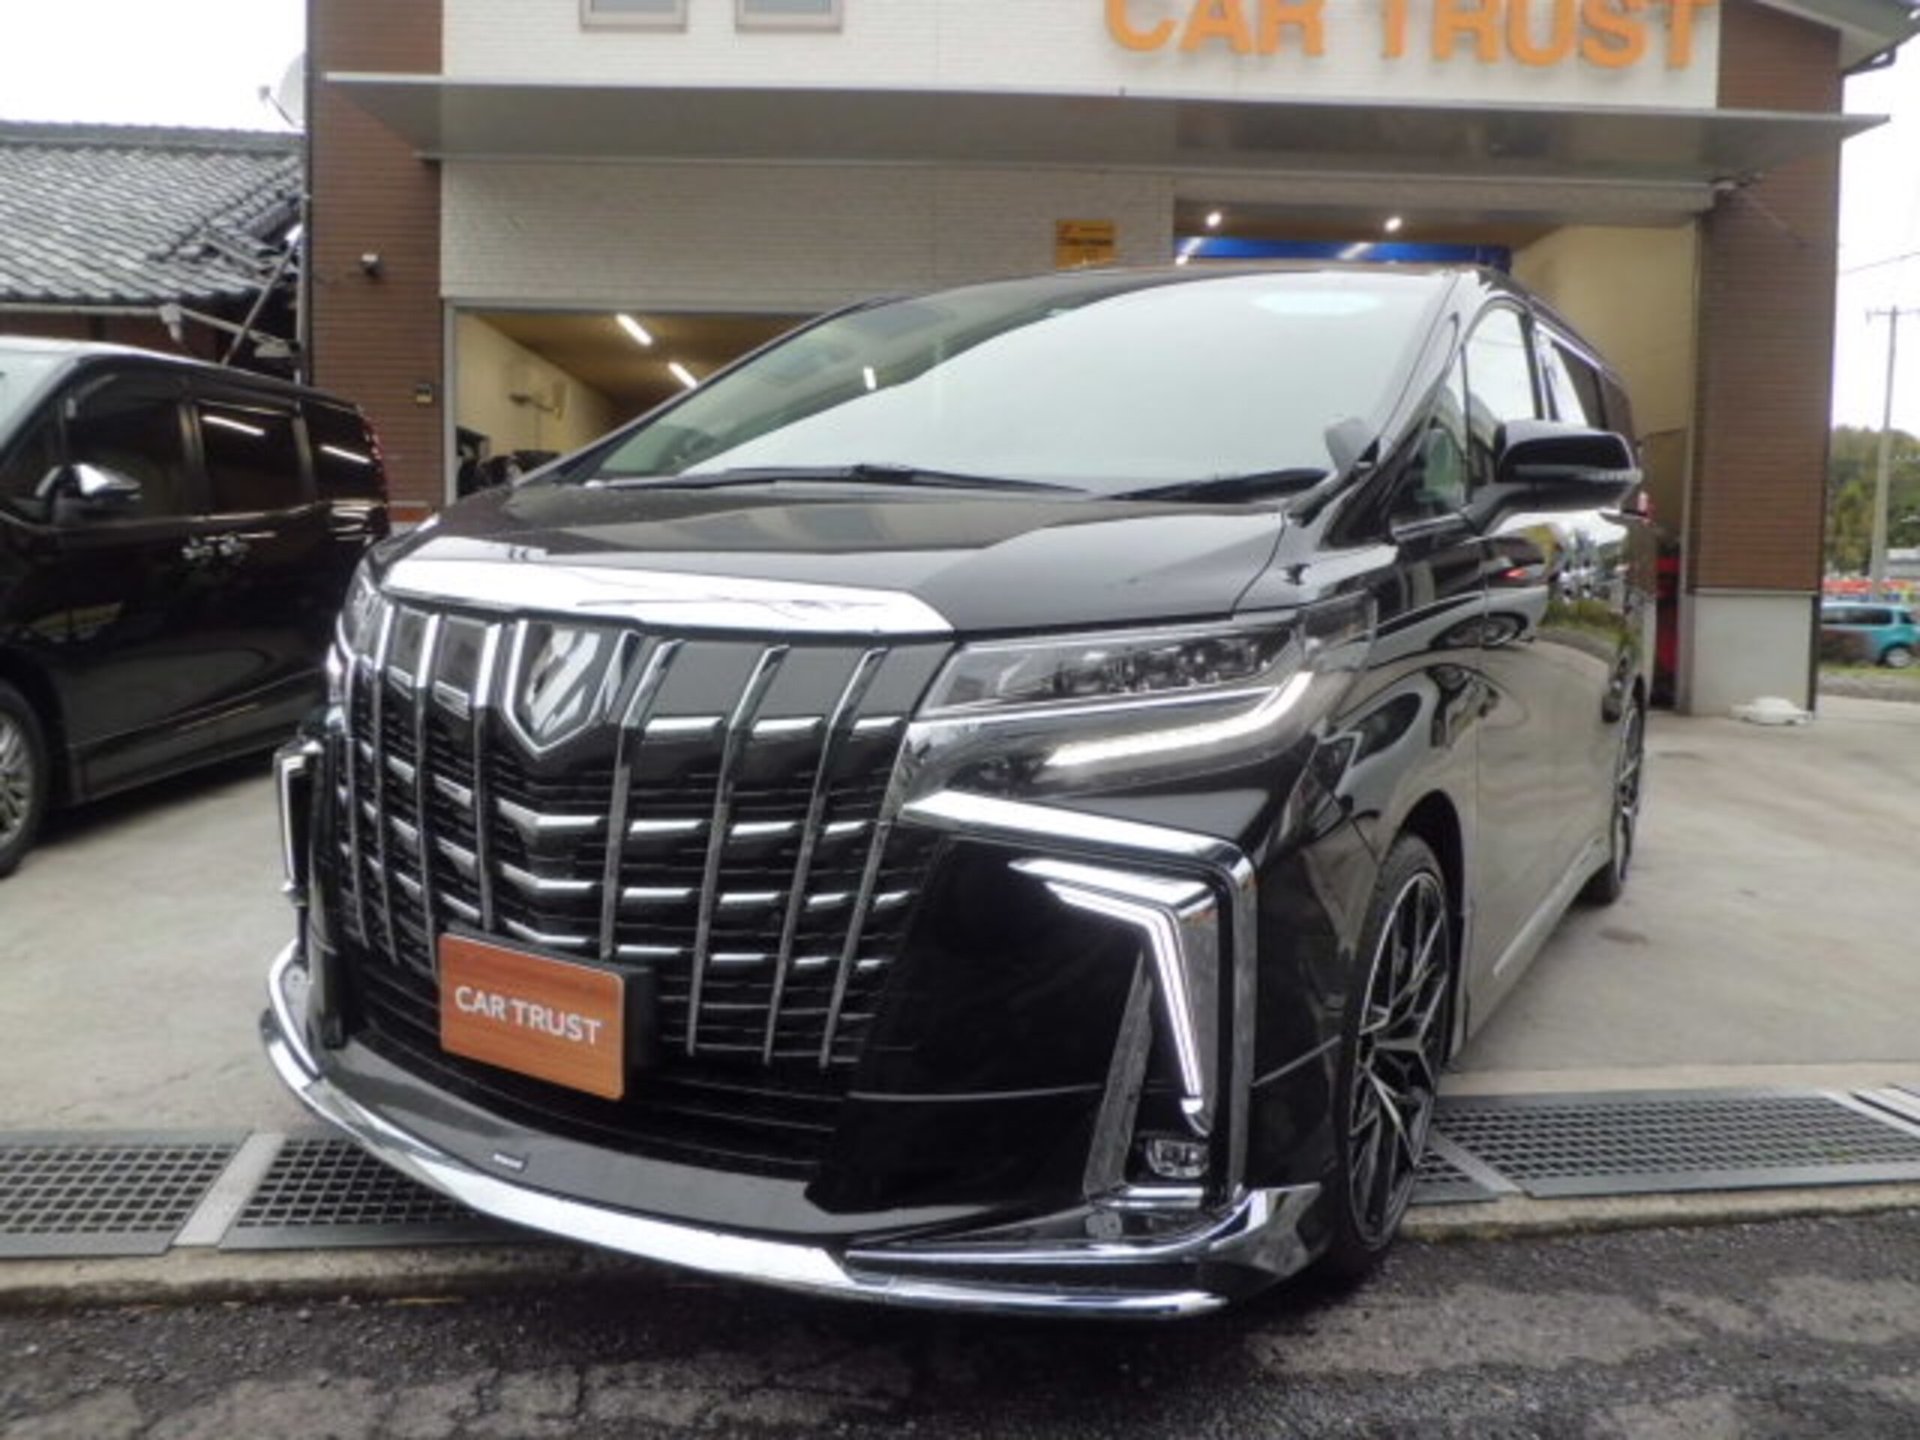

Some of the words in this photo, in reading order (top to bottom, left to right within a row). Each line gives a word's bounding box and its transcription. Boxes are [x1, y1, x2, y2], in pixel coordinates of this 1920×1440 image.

[1104, 0, 1325, 56] CAR
[455, 986, 506, 1021] CAR
[511, 999, 602, 1045] TRUST
